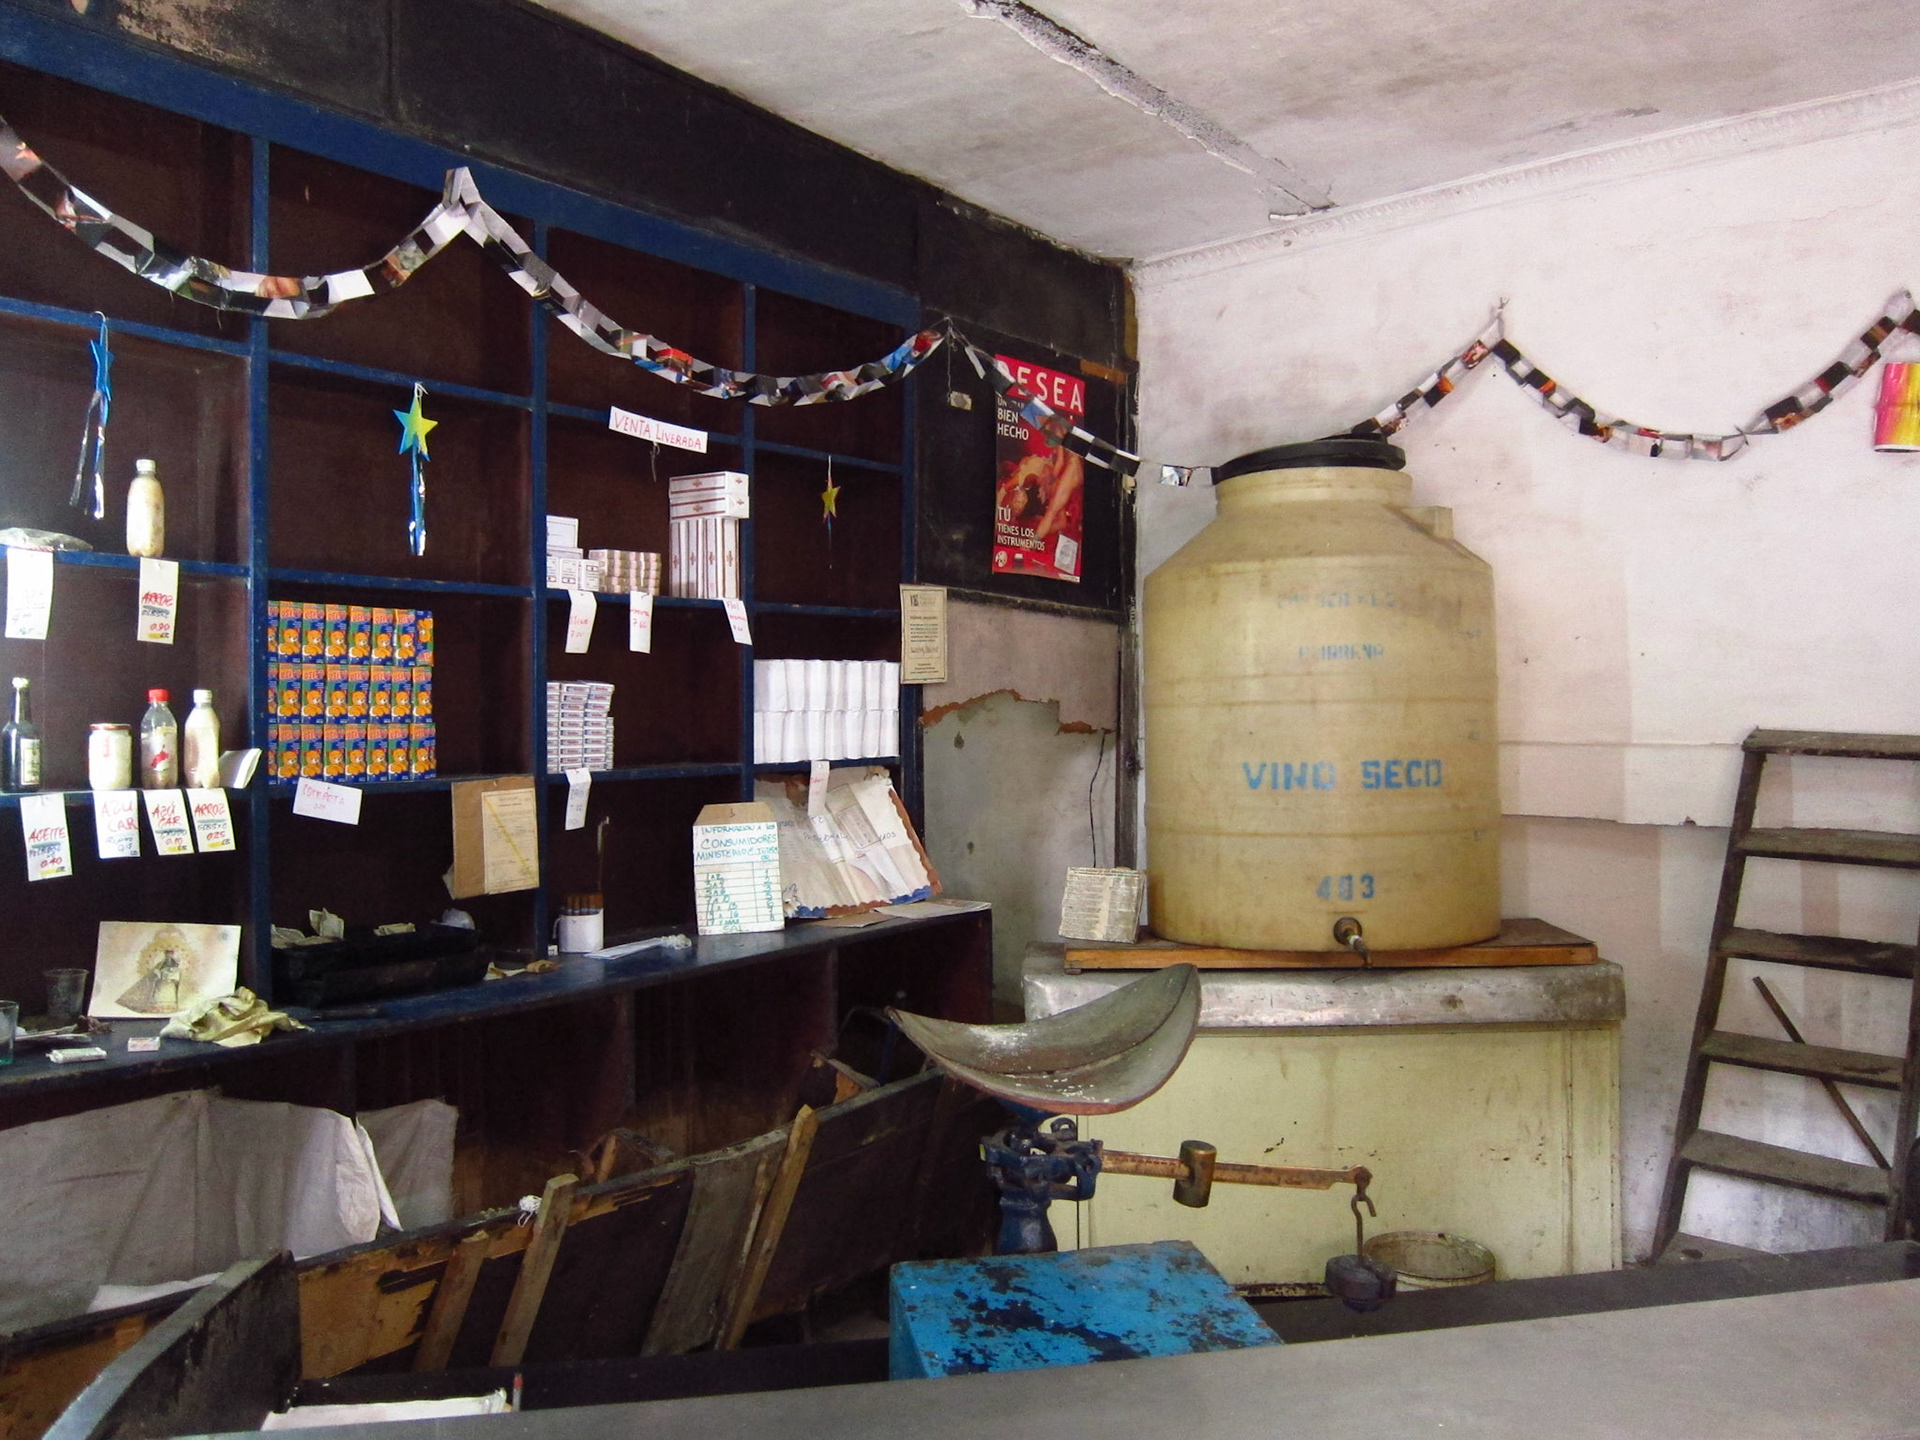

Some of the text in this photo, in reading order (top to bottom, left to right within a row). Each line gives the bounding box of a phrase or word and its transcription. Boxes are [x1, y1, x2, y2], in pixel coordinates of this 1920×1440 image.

[997, 360, 1084, 413] ESEA
[998, 407, 1019, 423] BIEN
[614, 411, 652, 439] VENTA
[997, 423, 1030, 441] HECHO
[998, 505, 1011, 522] TÚ
[998, 523, 1035, 538] TIENES LOS
[997, 534, 1046, 551] INSTRUMENTOS
[1242, 760, 1443, 790] VINO SECO
[28, 827, 67, 843] ACEITE
[700, 834, 777, 851] CONSUMIDORES
